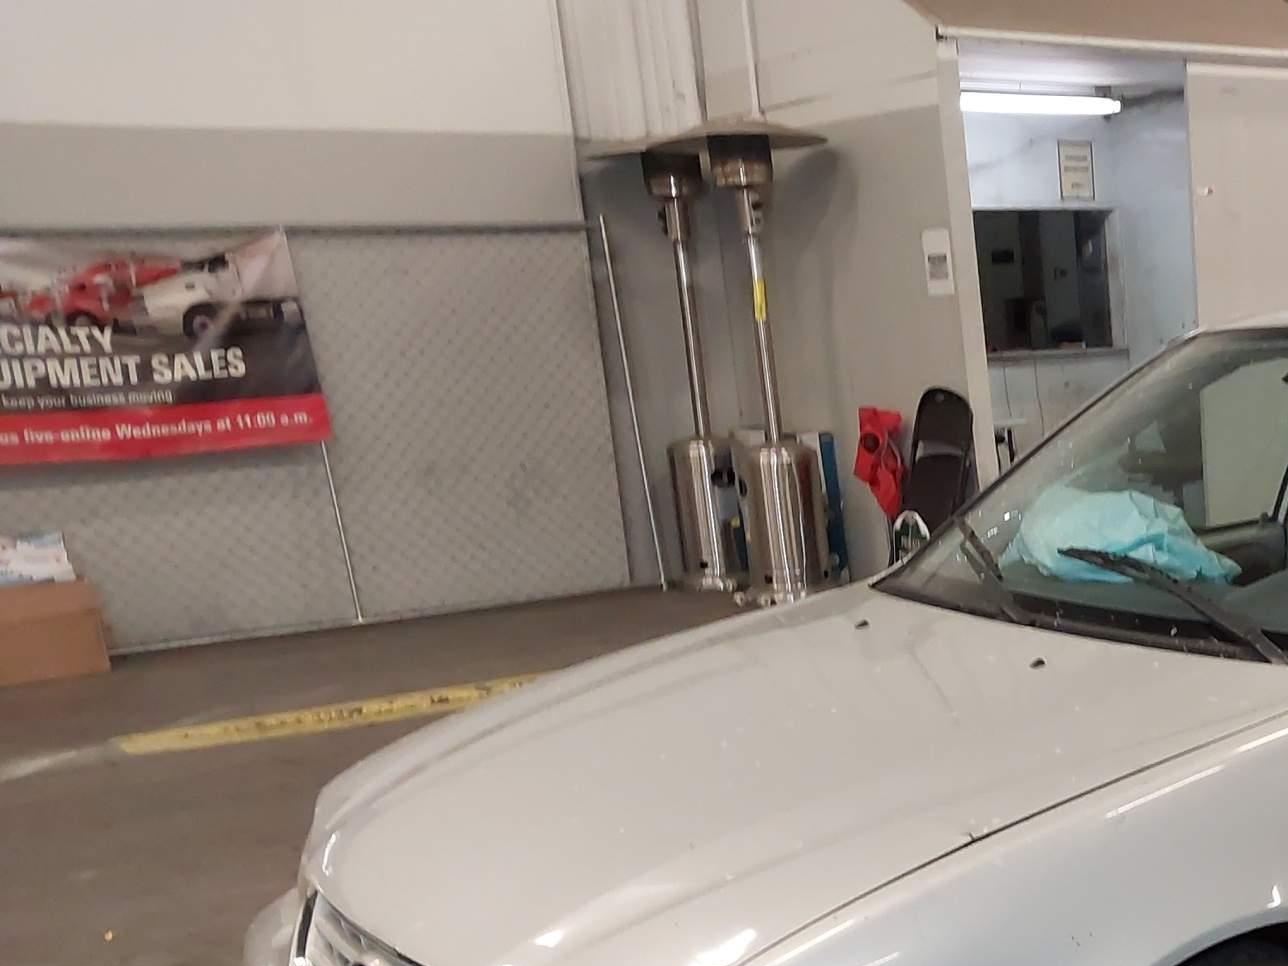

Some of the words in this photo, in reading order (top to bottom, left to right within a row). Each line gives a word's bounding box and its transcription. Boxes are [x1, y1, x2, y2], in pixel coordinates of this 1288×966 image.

[151, 346, 246, 384] SALES
[115, 418, 212, 441] Wednesdays
[216, 416, 231, 432] at
[236, 411, 276, 429] 11:00
